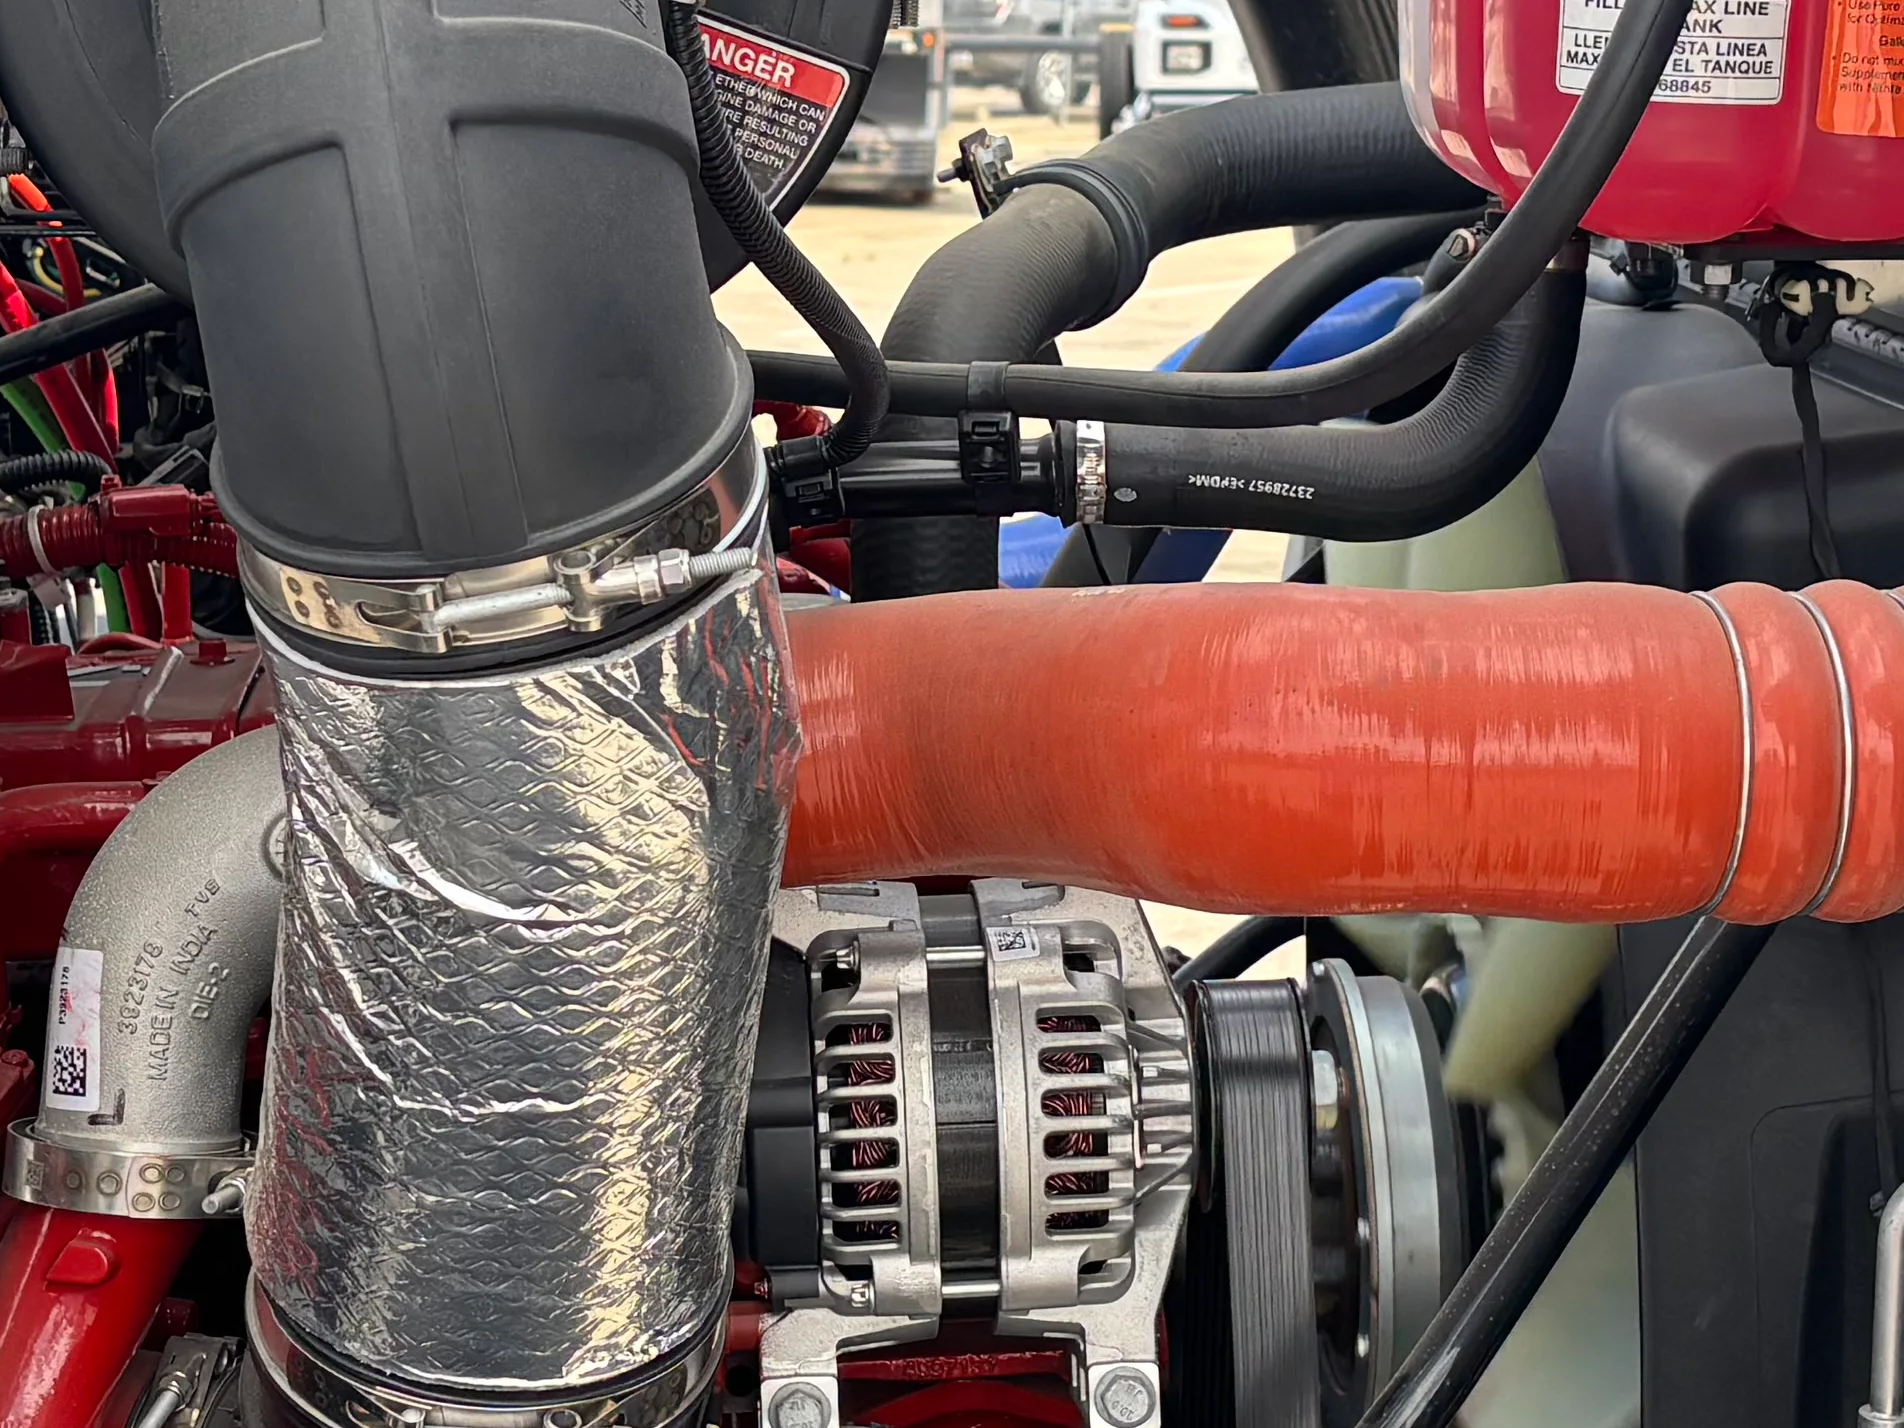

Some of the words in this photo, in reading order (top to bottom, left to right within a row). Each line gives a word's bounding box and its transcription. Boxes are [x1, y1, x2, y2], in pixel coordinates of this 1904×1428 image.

[1692, 0, 1716, 15] AX
[1724, 1, 1770, 16] LINE
[1848, 0, 1872, 10] Use
[1682, 19, 1723, 35] ANK
[1674, 40, 1709, 56] STA
[1716, 42, 1767, 57] LINEA
[1842, 52, 1859, 65] Do
[1861, 54, 1879, 65] not
[701, 33, 795, 88] ANGER
[1672, 58, 1694, 73] EL
[1701, 59, 1774, 75] TANQUE
[757, 89, 798, 110] WHICH
[799, 104, 826, 121] CAN
[745, 100, 797, 127] DAMAGE
[798, 120, 817, 134] OR
[744, 116, 809, 147] RESULTING
[734, 129, 800, 159] PERSONAL
[745, 148, 786, 170] DEATH.
[1248, 480, 1315, 500] 23728957
[169, 923, 218, 976] INDIA
[155, 986, 179, 1010] IN
[148, 1015, 173, 1082] MADE
